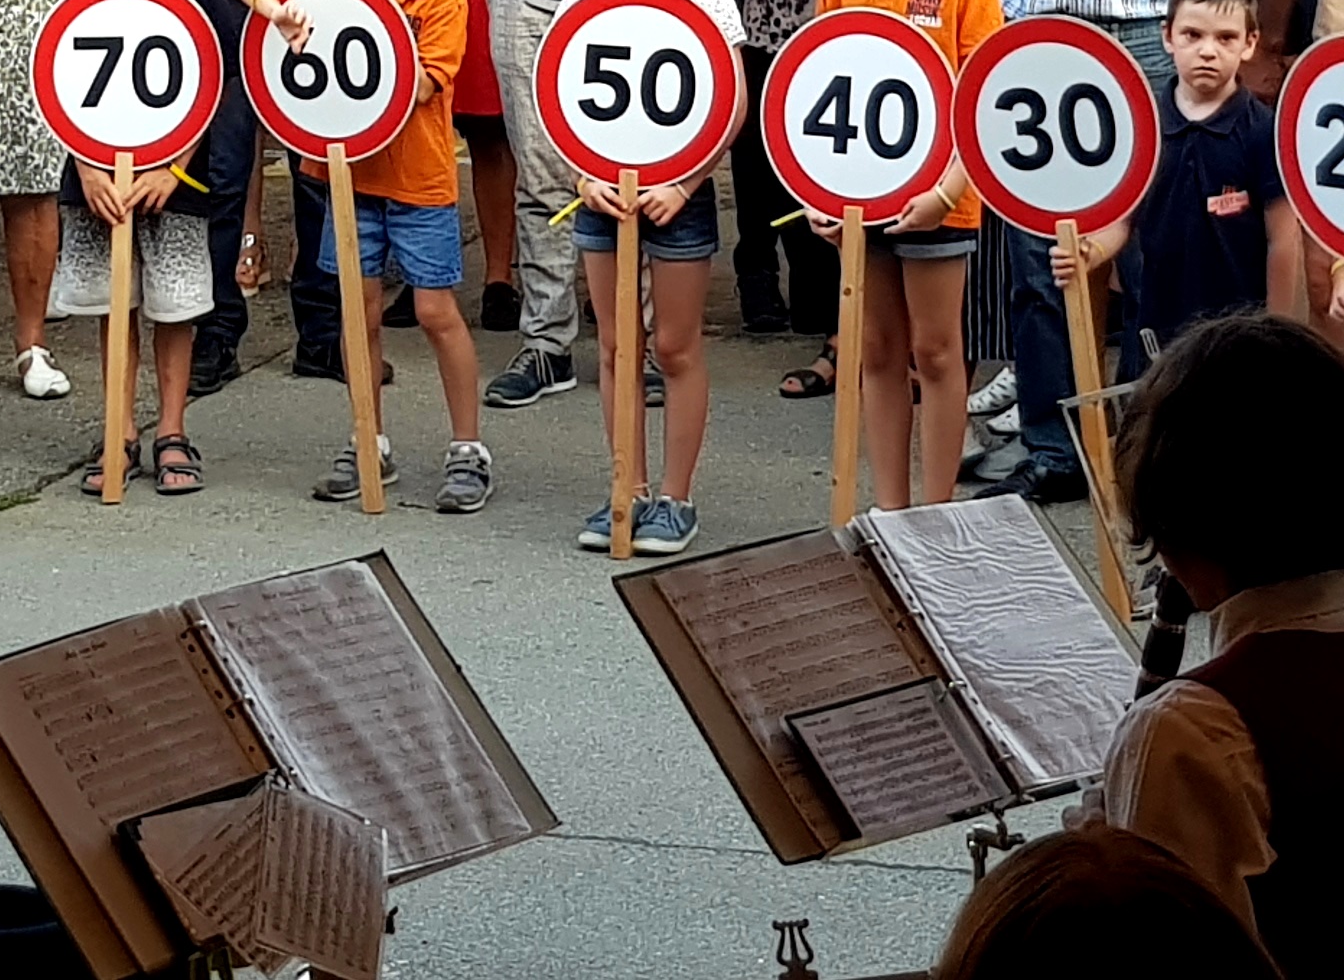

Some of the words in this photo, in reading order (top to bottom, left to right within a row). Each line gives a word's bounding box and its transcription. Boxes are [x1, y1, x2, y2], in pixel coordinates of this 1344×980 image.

[72, 34, 184, 109] 70
[280, 25, 381, 101] 60
[577, 43, 696, 127] 50
[802, 74, 919, 160] 40
[993, 82, 1117, 172] 30
